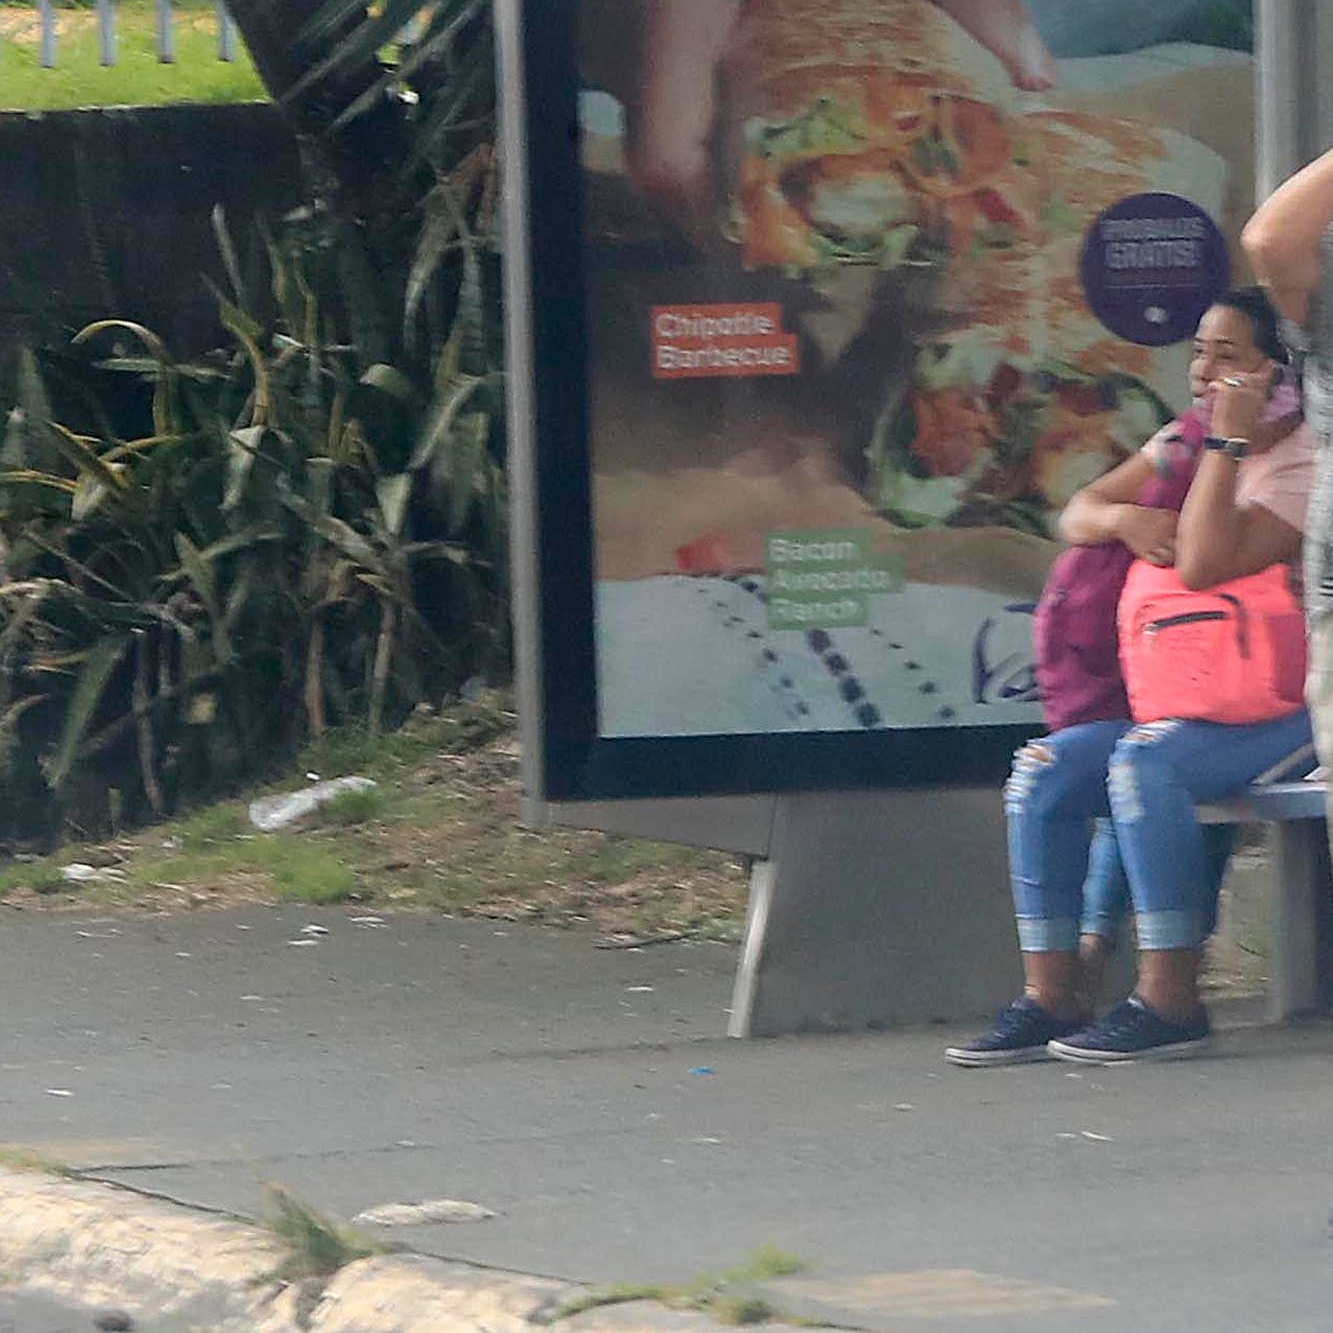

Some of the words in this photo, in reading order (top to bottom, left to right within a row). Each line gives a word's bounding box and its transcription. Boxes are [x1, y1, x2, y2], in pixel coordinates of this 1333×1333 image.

[655, 313, 774, 340] Chipotle
[657, 345, 790, 369] Barbecue
[768, 538, 855, 562] Bacon
